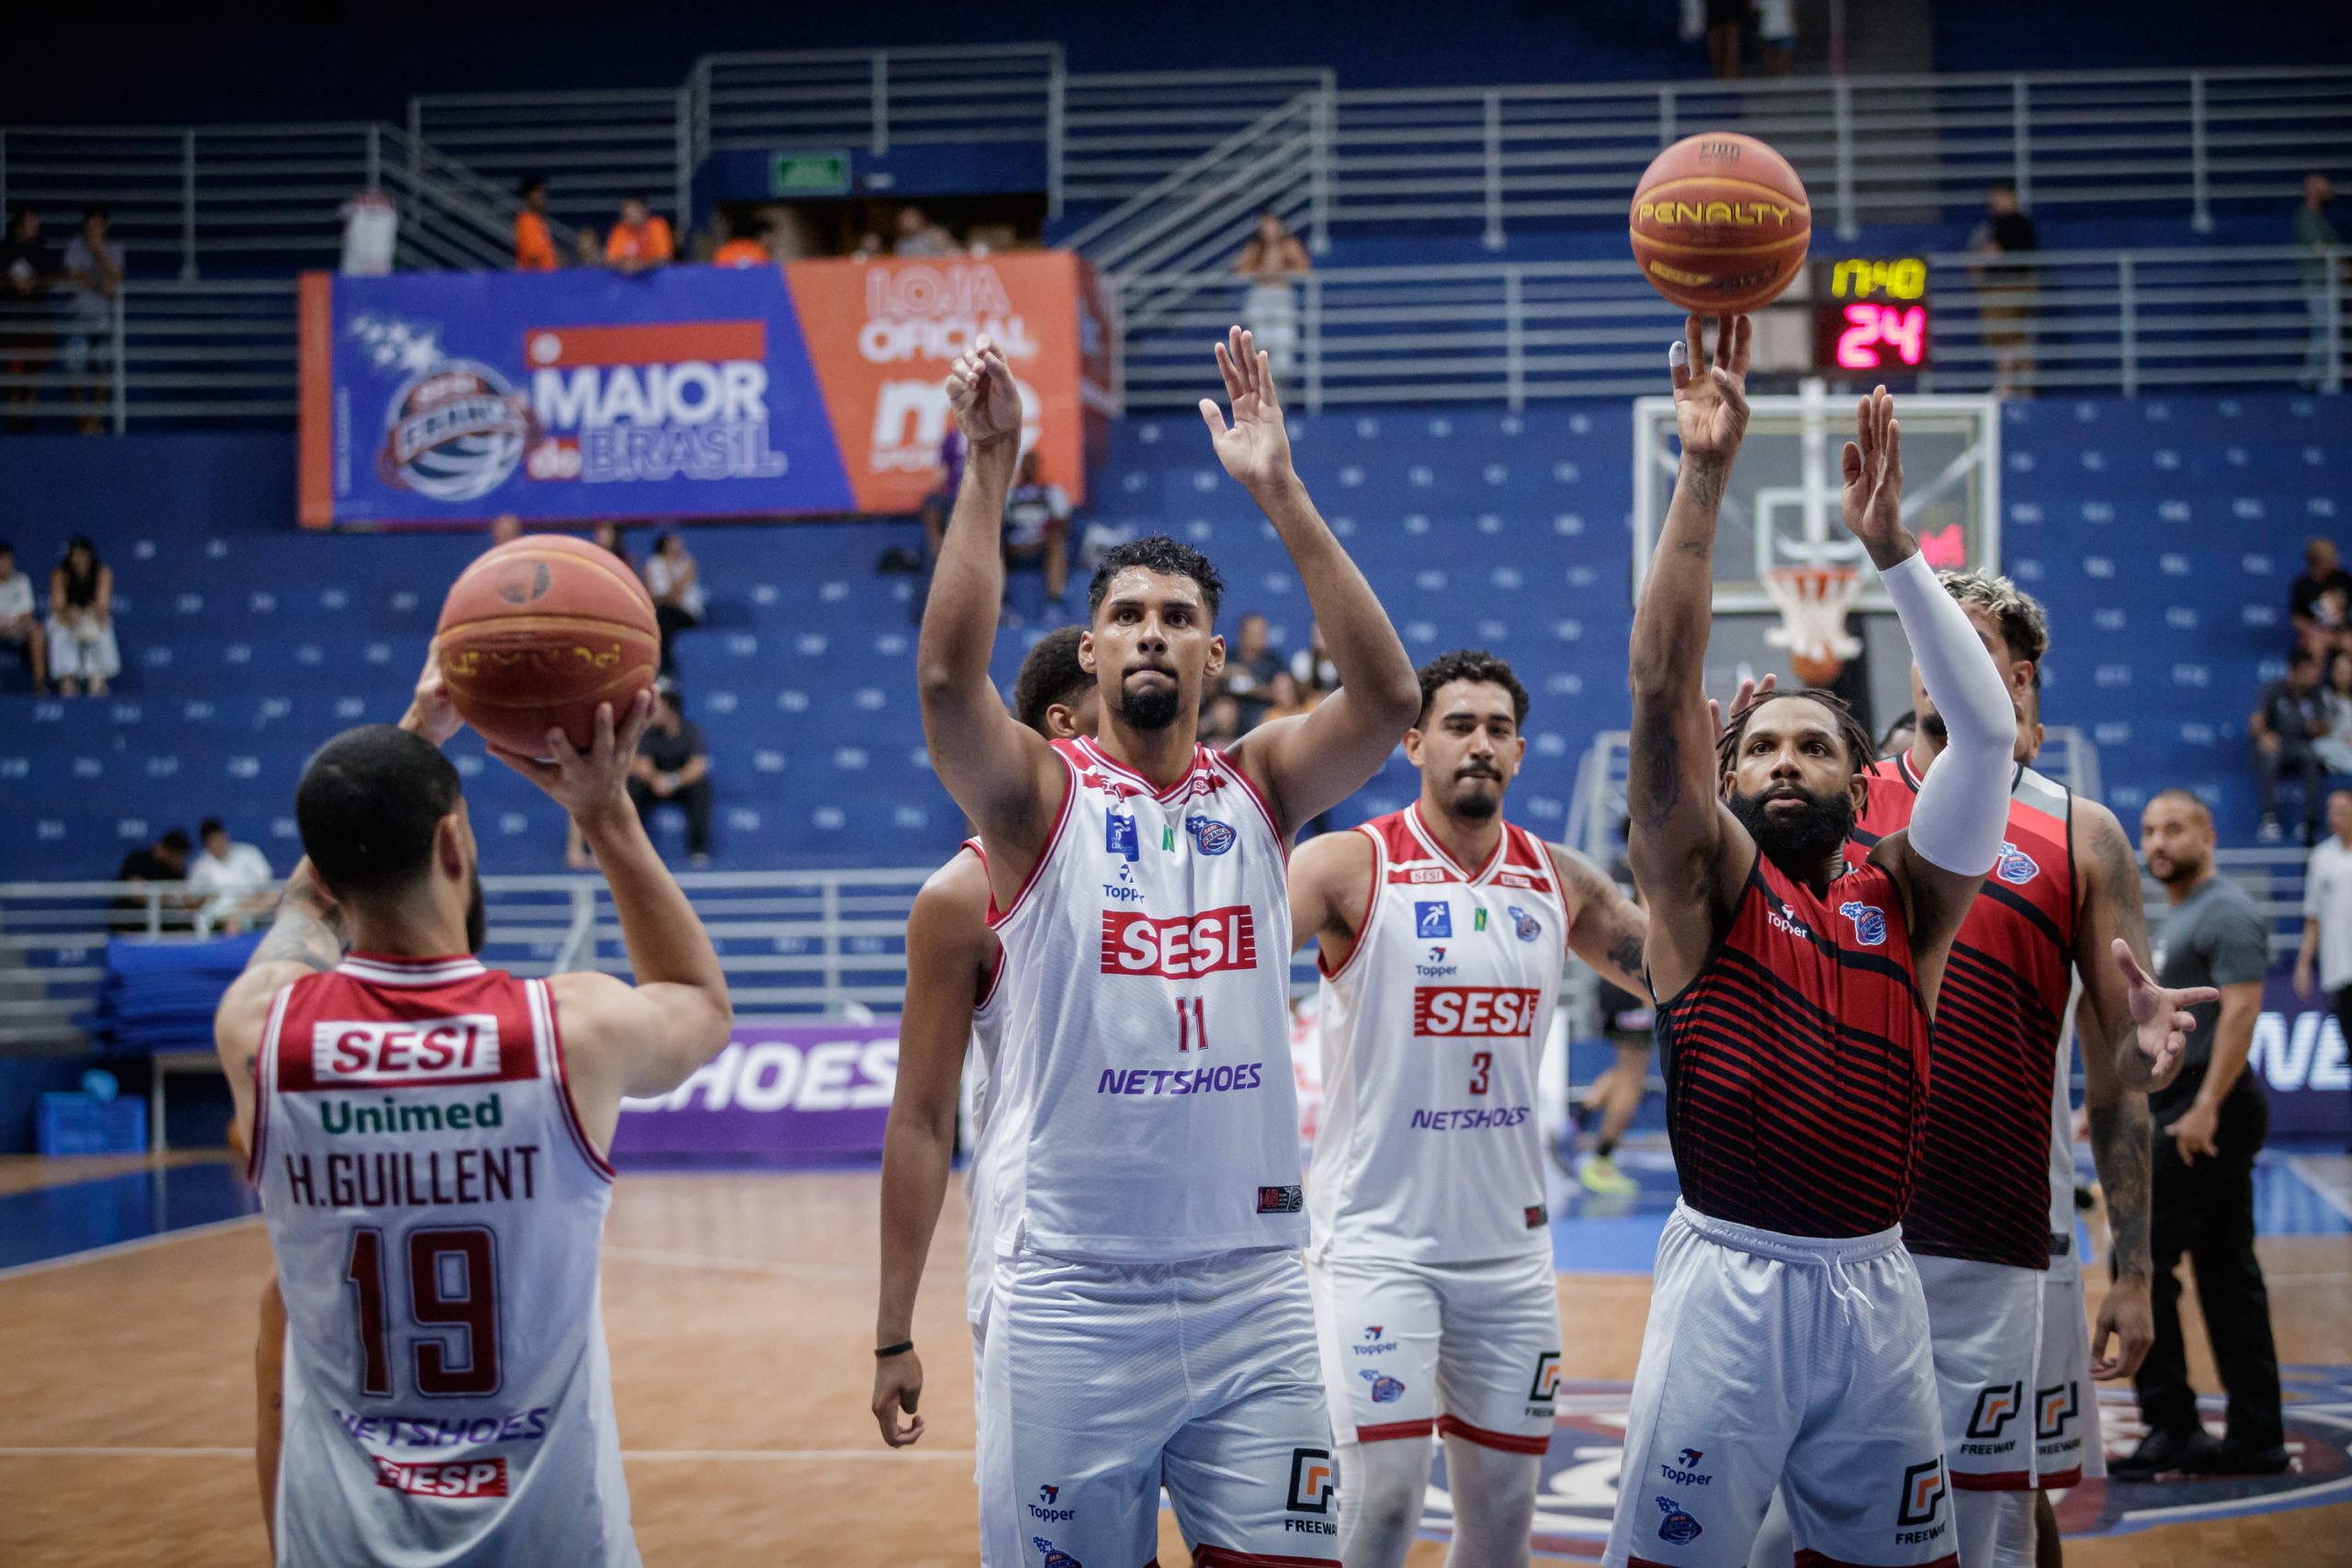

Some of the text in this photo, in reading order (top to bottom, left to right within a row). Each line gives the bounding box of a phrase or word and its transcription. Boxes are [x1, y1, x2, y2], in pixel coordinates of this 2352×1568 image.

[1639, 201, 1791, 227] PENALTY
[865, 264, 1012, 319] LOJA
[1838, 303, 1926, 368] 24
[533, 359, 770, 430] MAIOR
[580, 423, 788, 482] BRASIL
[1117, 915, 1238, 975] SESI
[1416, 965, 1457, 978] Topper
[1175, 996, 1208, 1053] 11
[1426, 992, 1530, 1034] SESI
[332, 1024, 479, 1074] SESI
[1098, 1063, 1262, 1095] NETSHOES
[1470, 1052, 1492, 1095] 3
[321, 1093, 503, 1134] Unimed
[287, 1145, 540, 1207] H.GUILLENT
[345, 1224, 503, 1398] 19
[1352, 1342, 1397, 1356] Topper
[1960, 1439, 2017, 1455] FREEWAY
[1661, 1464, 1713, 1486] Topper
[1028, 1504, 1075, 1523] Topper
